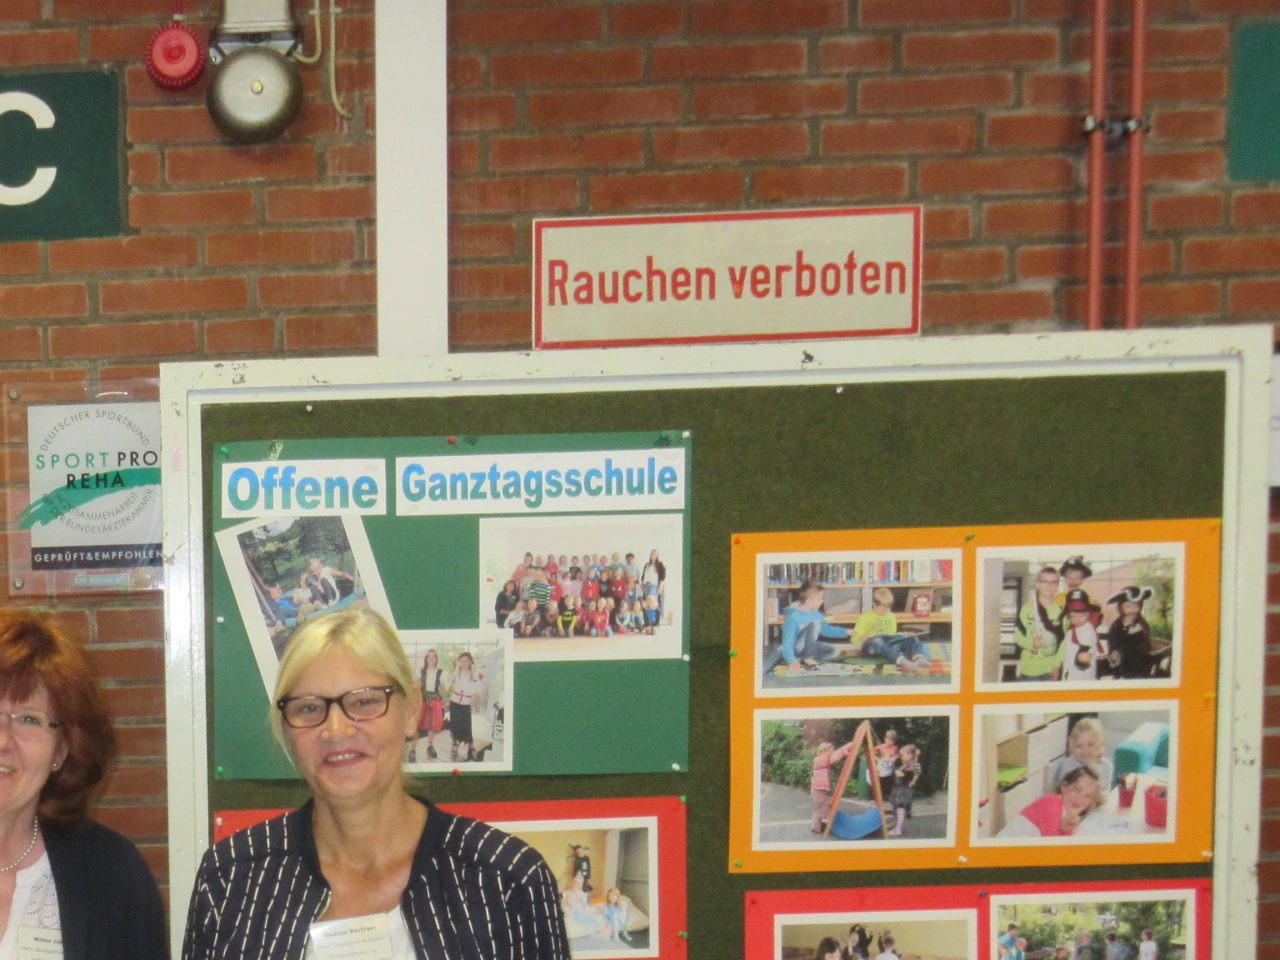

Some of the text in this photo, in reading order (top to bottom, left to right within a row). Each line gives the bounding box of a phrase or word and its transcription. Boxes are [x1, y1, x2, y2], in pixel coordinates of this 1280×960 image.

[547, 248, 908, 307] Rauchen verboten
[40, 409, 150, 452] DEUTSCHER SPORTBUND
[36, 450, 159, 469] SPORT PRO
[66, 472, 125, 489] REHA
[227, 457, 678, 511] Offene Ganztagsschule
